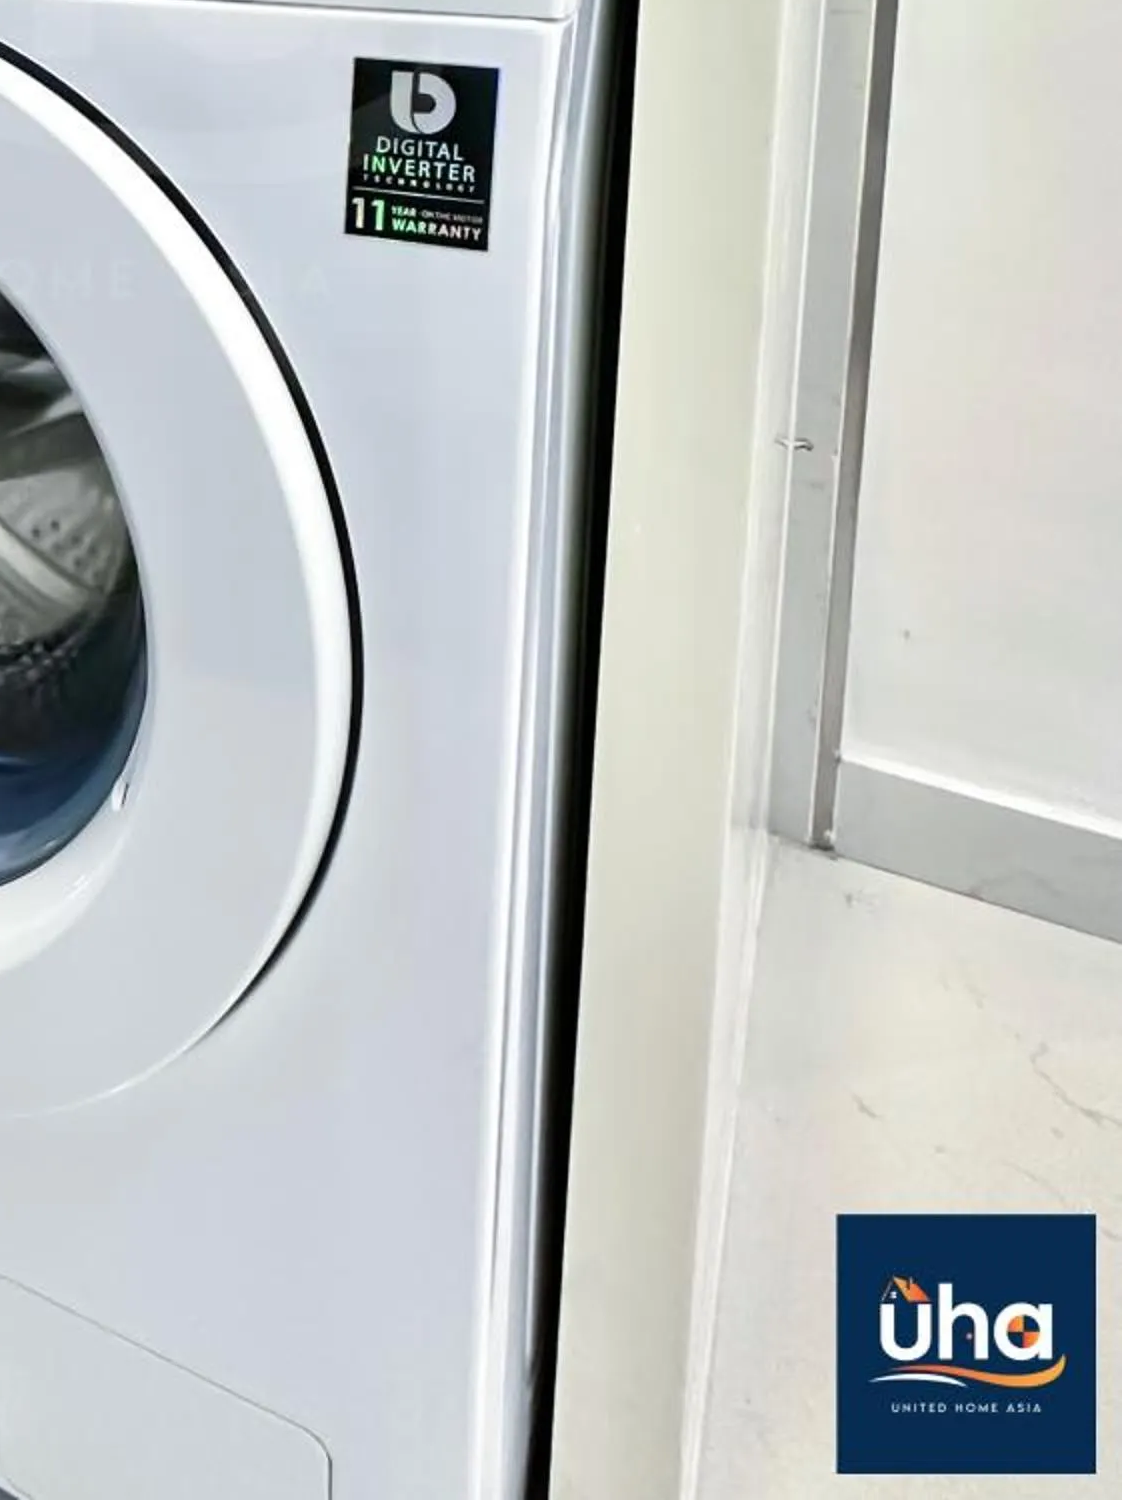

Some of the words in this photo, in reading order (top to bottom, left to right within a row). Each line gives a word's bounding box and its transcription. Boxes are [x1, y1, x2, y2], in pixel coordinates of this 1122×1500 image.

[377, 136, 464, 162] DIGITAL
[363, 154, 477, 183] INVERTER
[352, 197, 386, 231] 11
[391, 205, 417, 217] YEAR
[391, 217, 483, 242] WARRANTY
